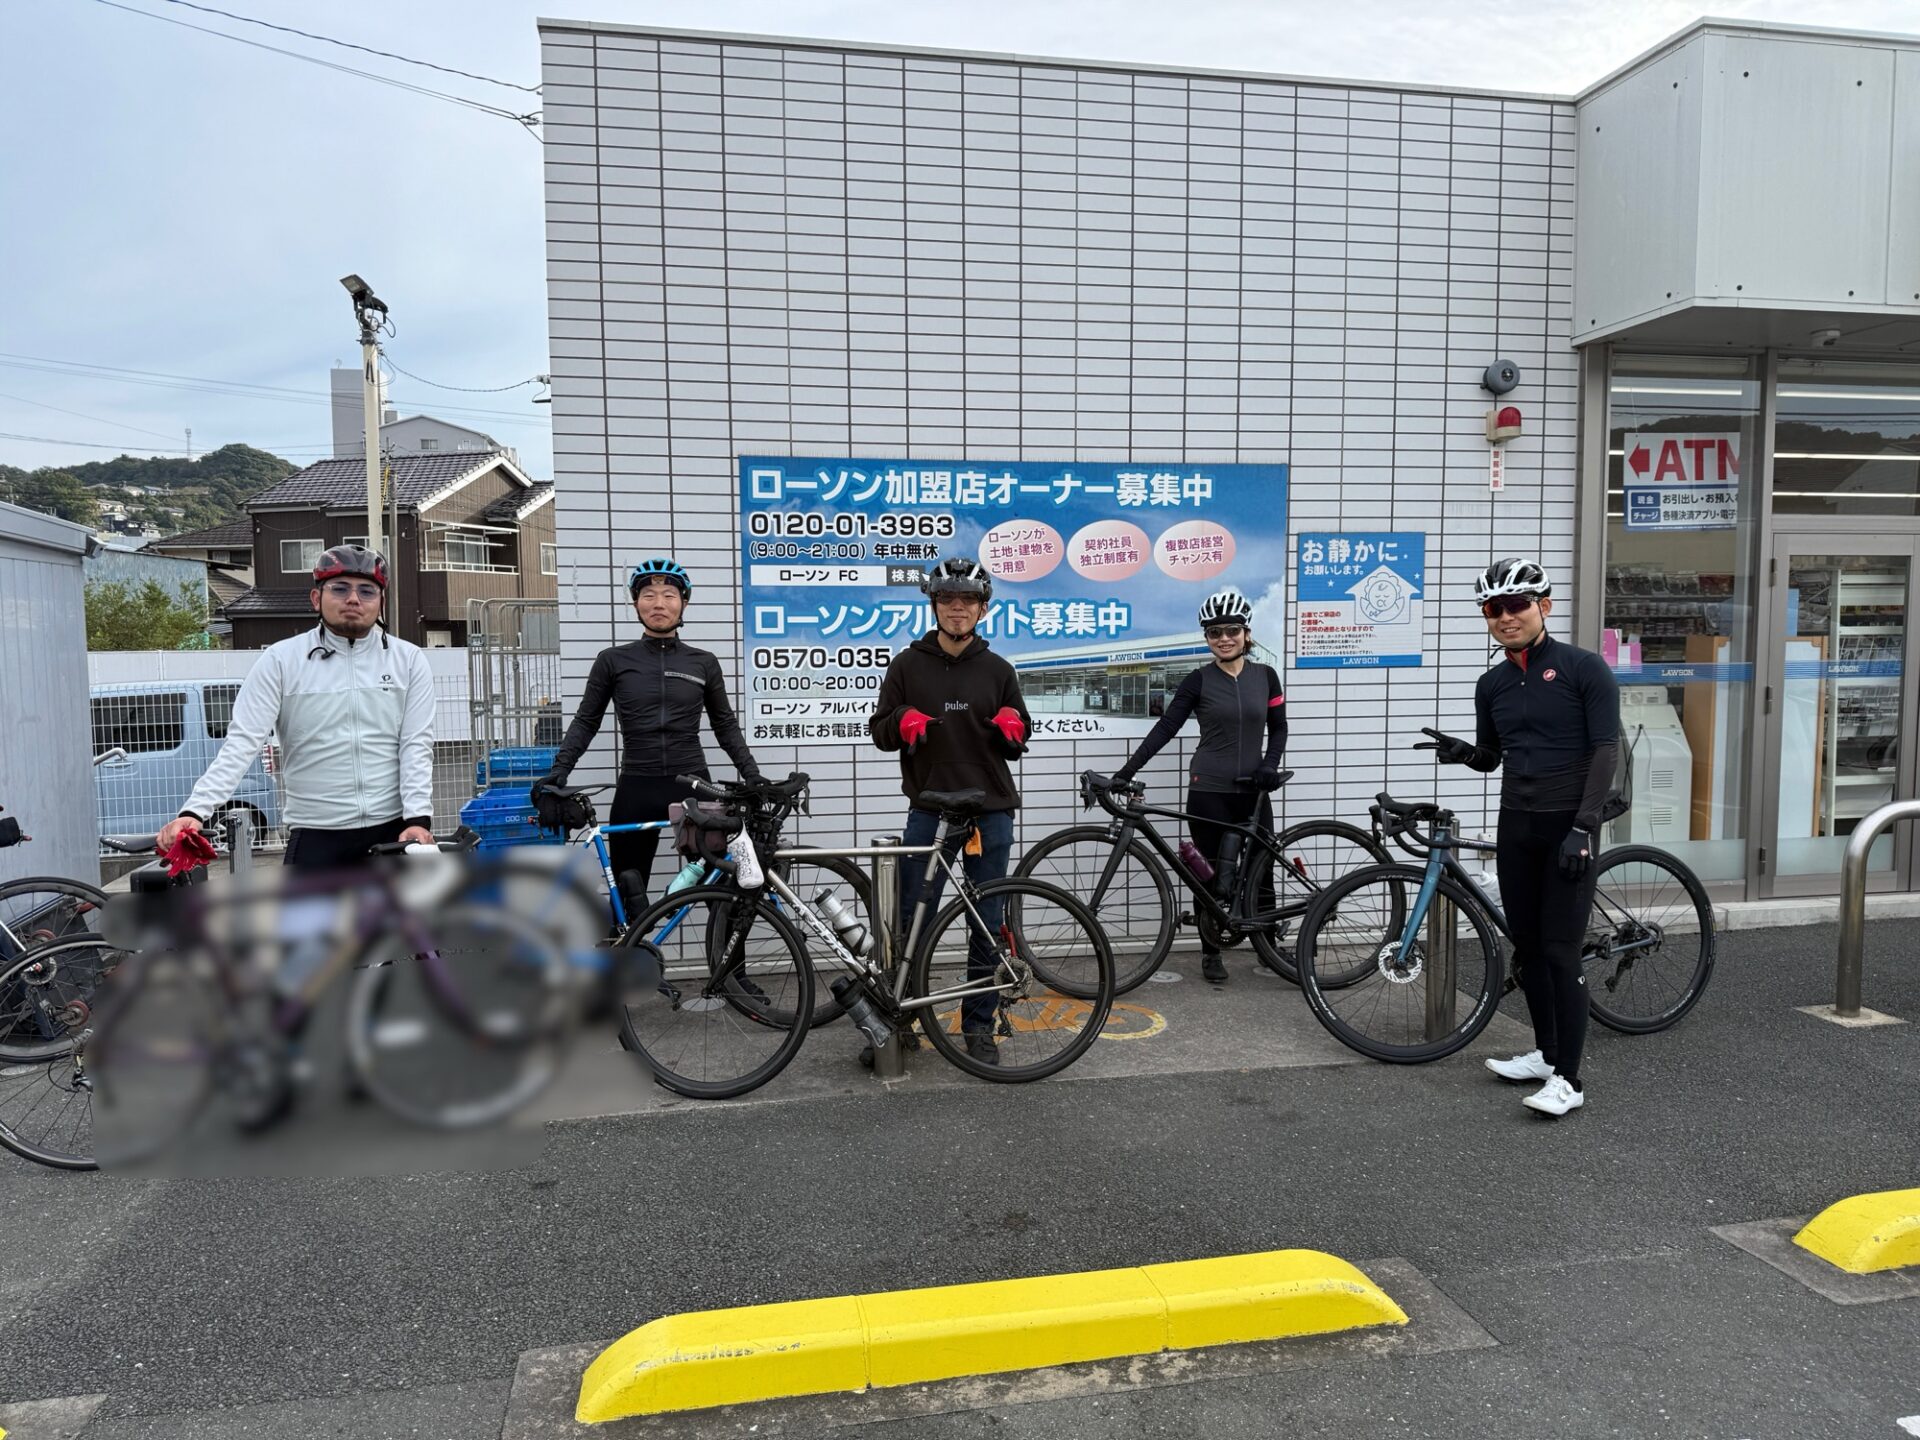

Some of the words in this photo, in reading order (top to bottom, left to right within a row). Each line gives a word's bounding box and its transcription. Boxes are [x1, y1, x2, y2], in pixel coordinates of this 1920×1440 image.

[752, 469, 1212, 506] ローソン加盟店オーナー募集中
[1633, 511, 1659, 520] チャージ
[1662, 508, 1737, 521] 各種決済アプリ・電子
[751, 514, 954, 537] 0120-01-3963
[988, 527, 1046, 544] ローソンが
[1084, 536, 1133, 551] 契約社員
[1165, 535, 1224, 552] 複数店経営
[873, 543, 939, 559] 年中無休
[989, 542, 1055, 560] 土地・建物を
[1080, 550, 1139, 567] 独立制度有
[1168, 550, 1223, 566] チャンス有
[1302, 538, 1398, 563] お静かに
[991, 560, 1026, 574] ご用意
[779, 570, 830, 582] ローソン
[839, 570, 859, 582] FC
[891, 569, 920, 583] 検索
[755, 602, 1128, 636] ローソンアルイト募集中
[754, 648, 890, 669] 0570-035
[1110, 652, 1142, 662] LAWSON
[1343, 657, 1380, 665] LAWSON
[761, 703, 811, 715] ローソン
[945, 700, 968, 712] pulse
